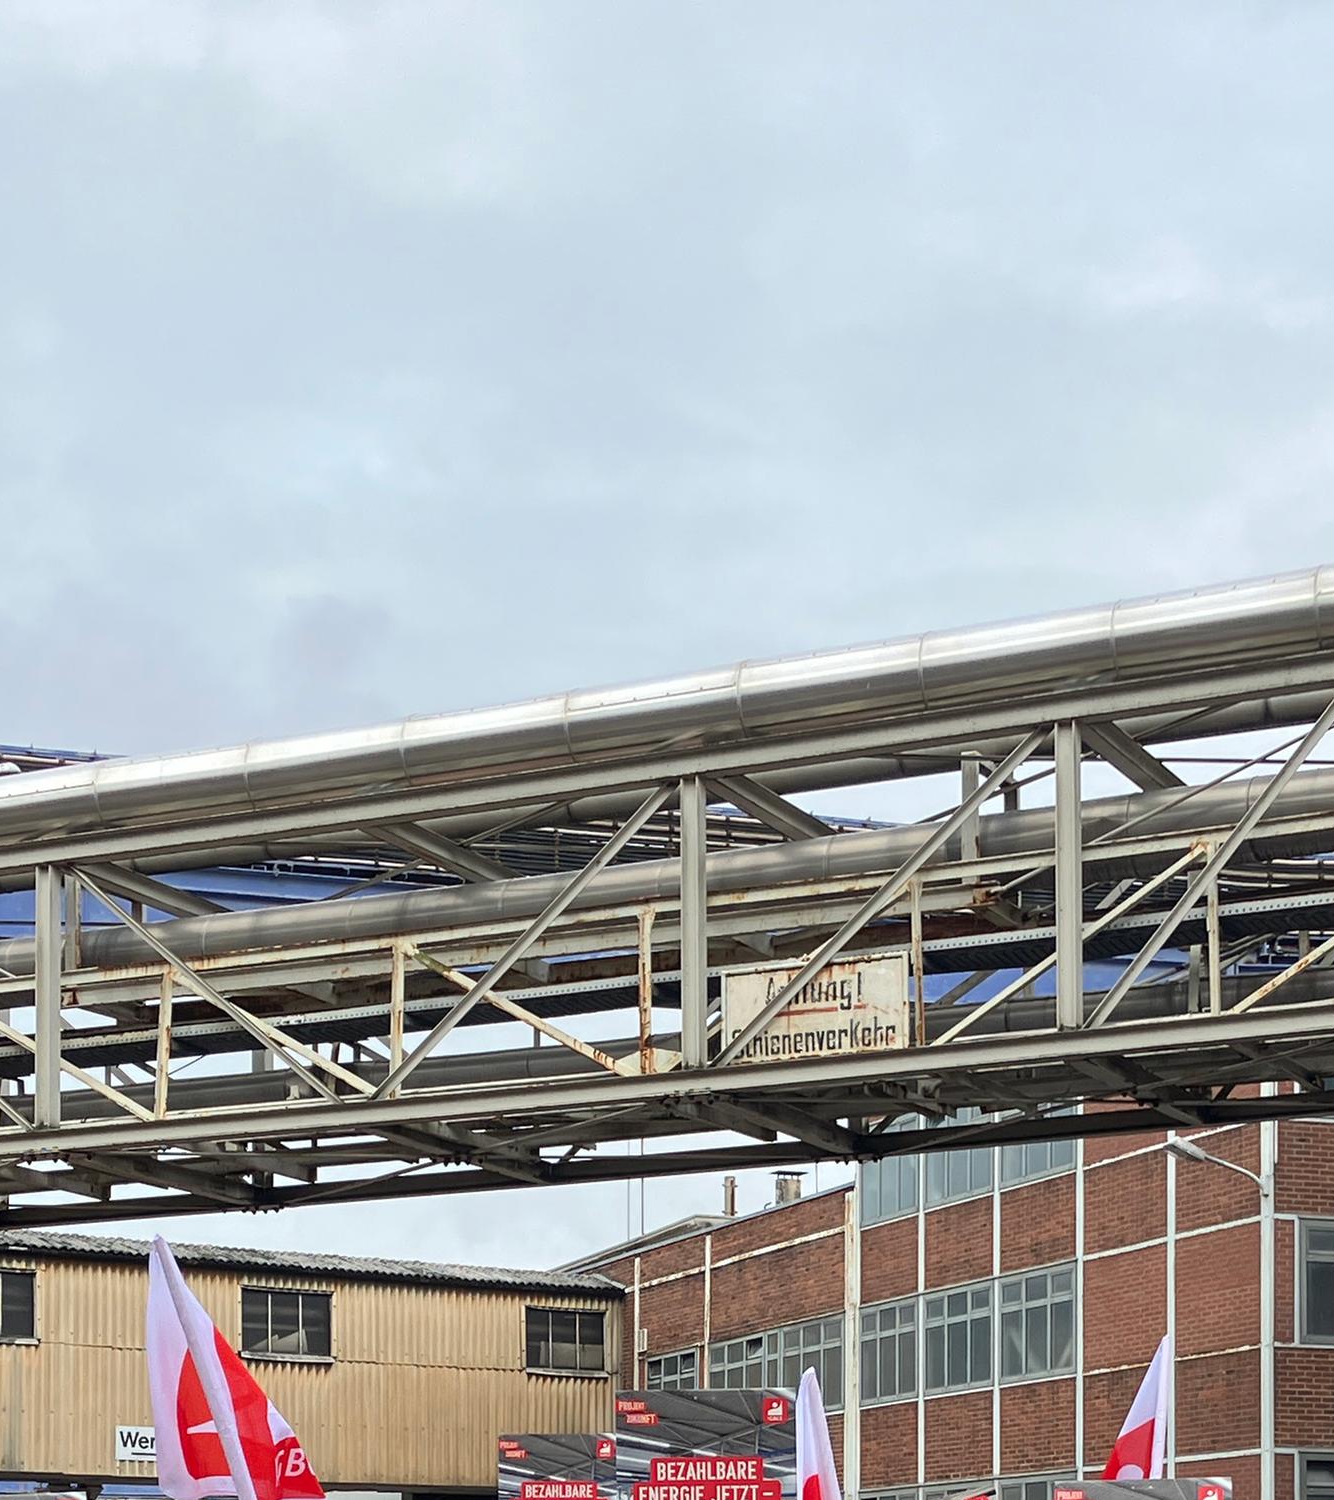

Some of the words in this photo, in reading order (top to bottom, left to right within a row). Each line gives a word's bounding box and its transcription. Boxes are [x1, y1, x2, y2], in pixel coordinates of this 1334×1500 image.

[119, 1431, 155, 1449] Wer
[656, 1461, 758, 1481] BEZAHLBARE
[525, 1484, 593, 1498] BEZAHLBARE
